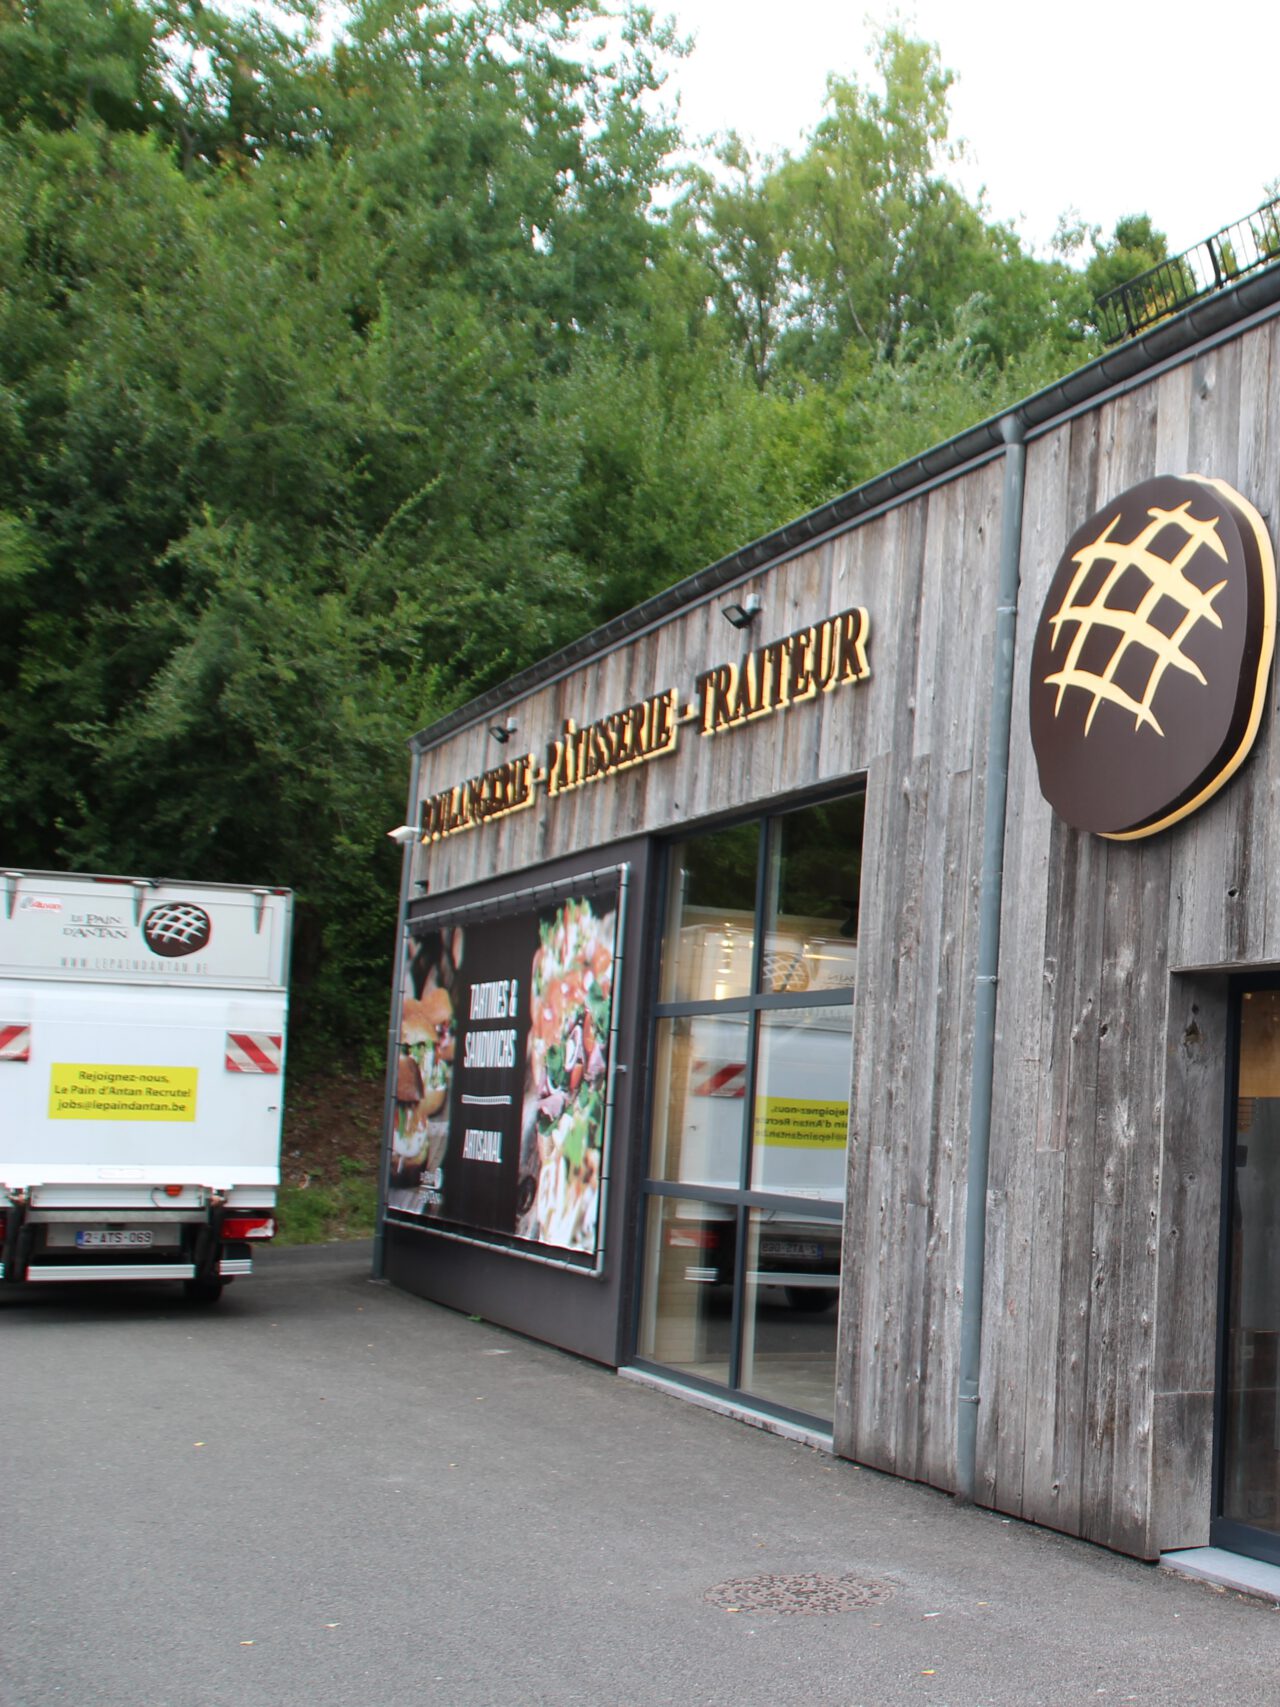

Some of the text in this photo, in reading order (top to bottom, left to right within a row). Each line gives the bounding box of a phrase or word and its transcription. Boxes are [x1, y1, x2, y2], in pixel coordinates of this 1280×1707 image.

[695, 606, 871, 736] TRAITEUR
[470, 979, 518, 1020] TARTINES &
[464, 1029, 517, 1068] SANDWICHS
[54, 1085, 67, 1094] Le
[71, 1085, 95, 1095] Pain
[463, 1129, 502, 1163] ARTISANAL
